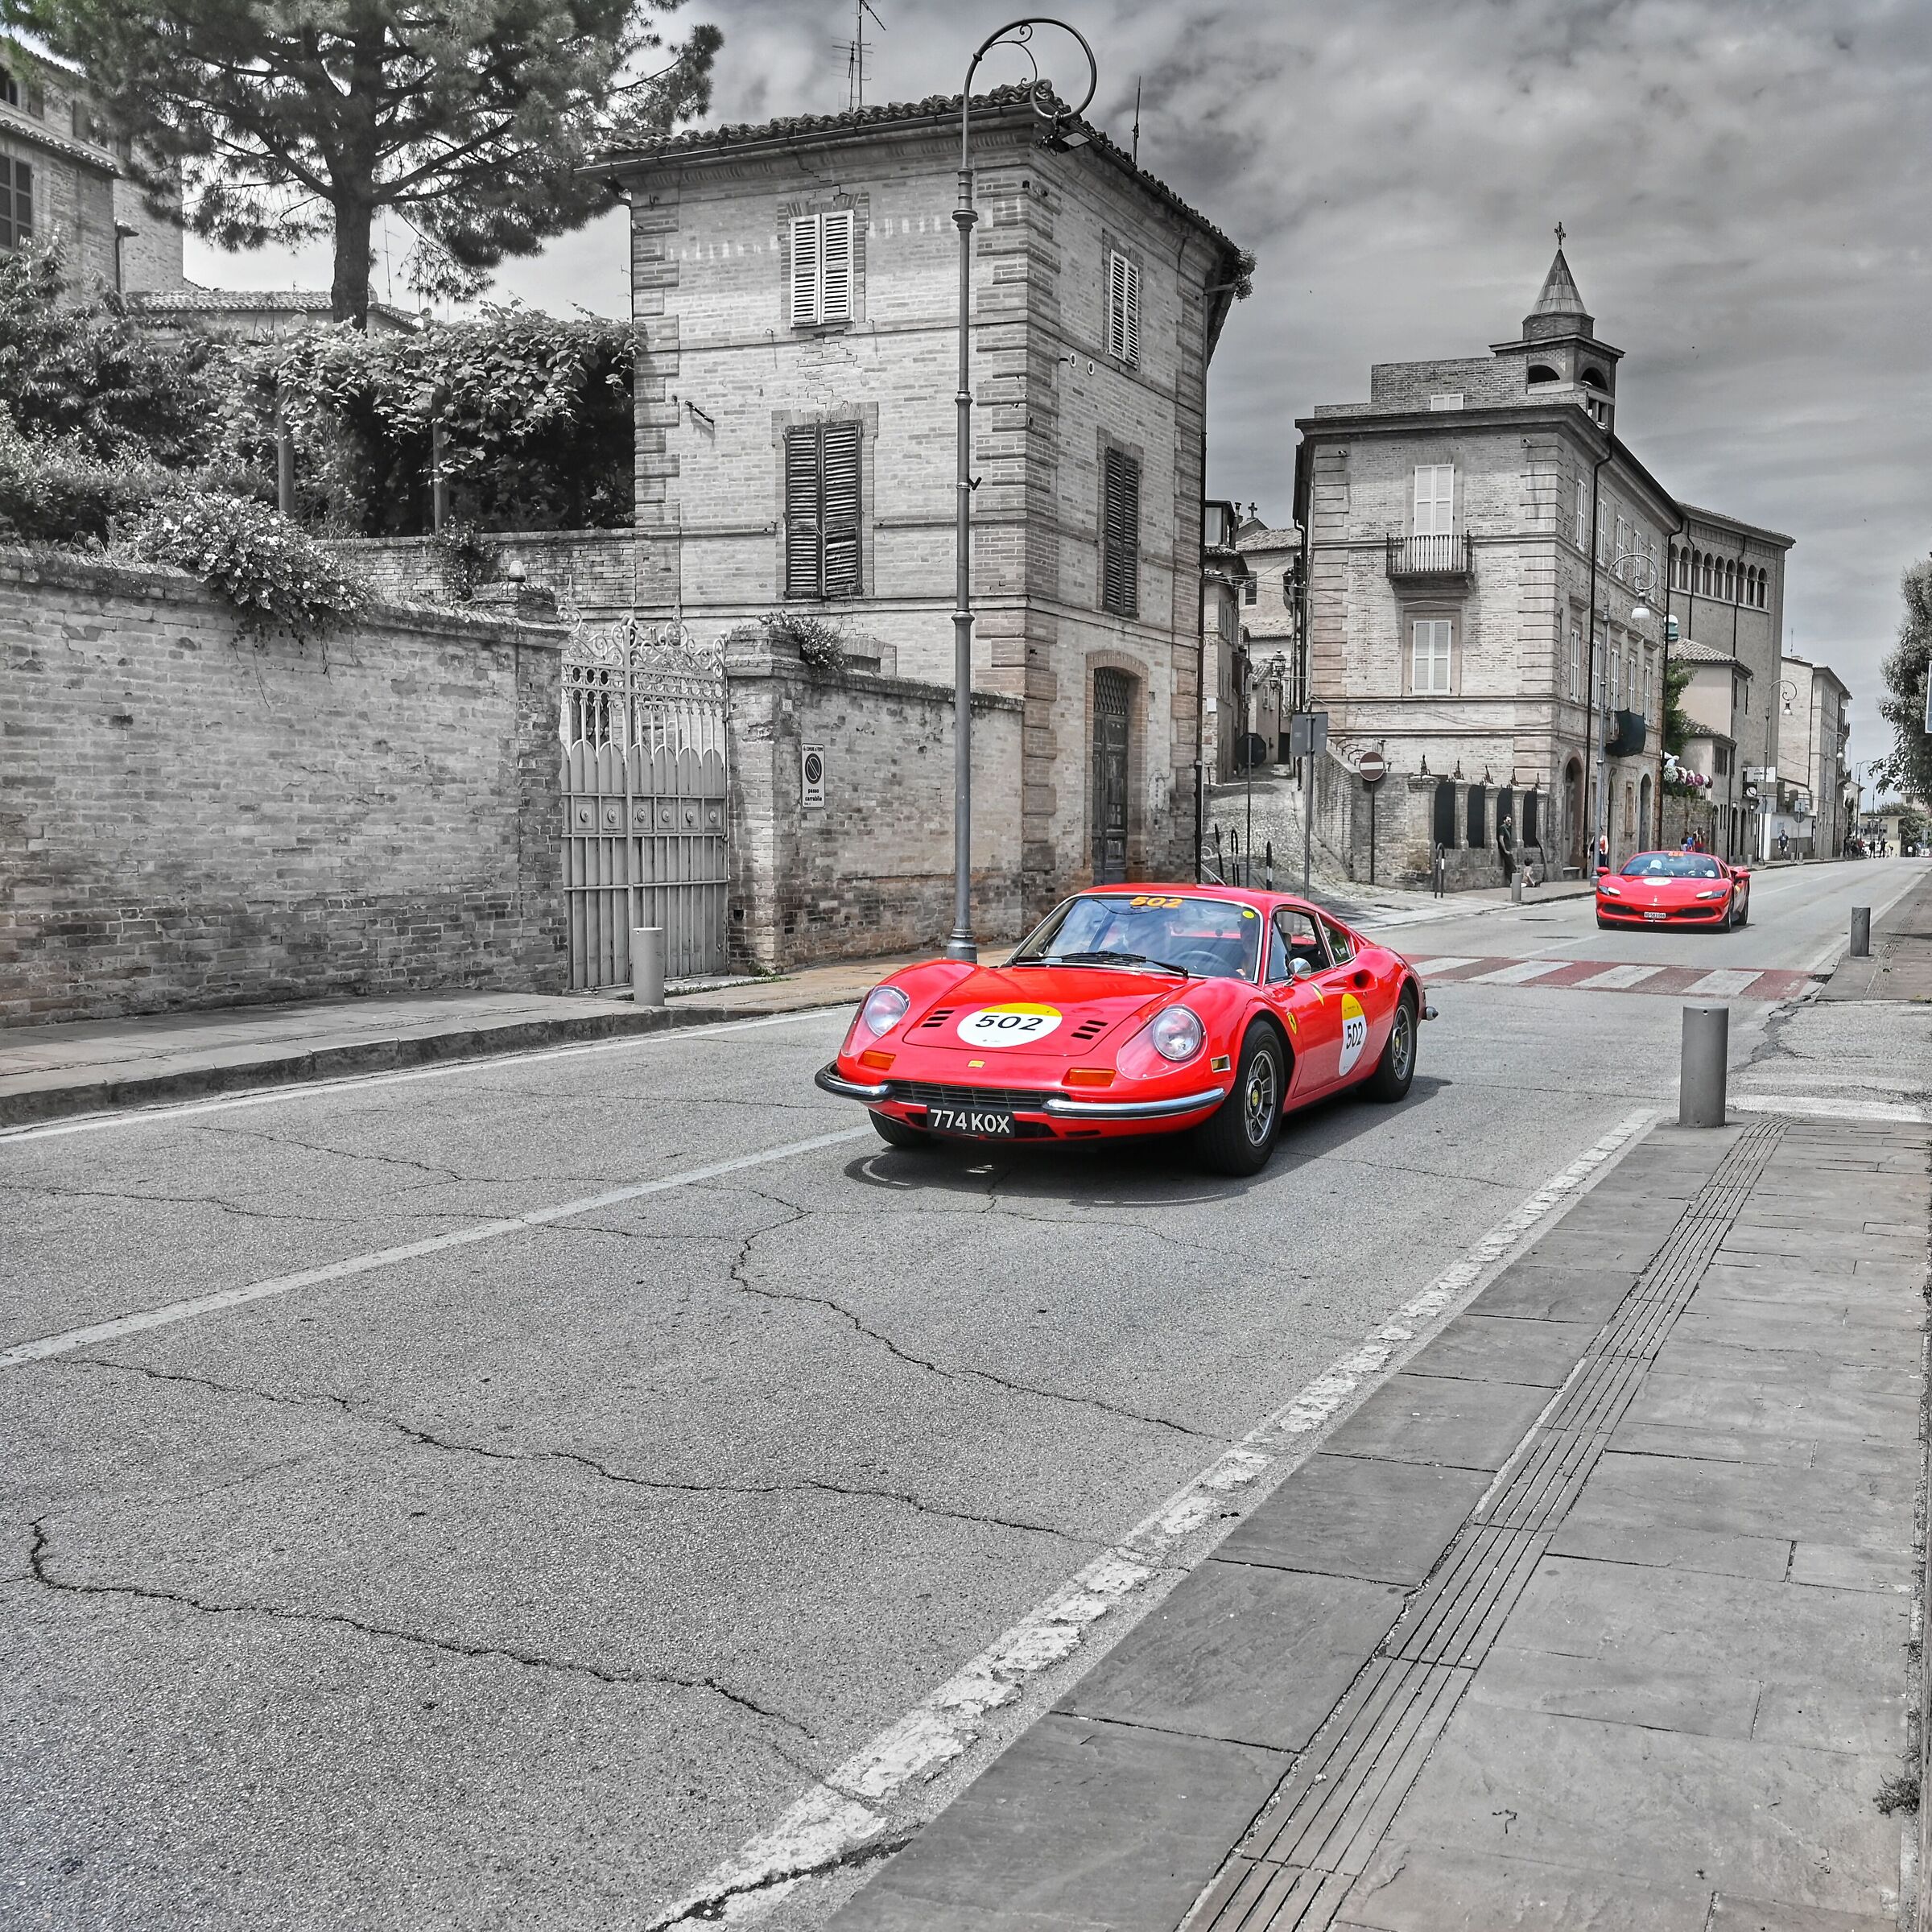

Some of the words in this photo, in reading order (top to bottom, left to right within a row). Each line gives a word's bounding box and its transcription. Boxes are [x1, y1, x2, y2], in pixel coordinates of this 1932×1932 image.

[1129, 896, 1183, 909] 502
[975, 1015, 1043, 1031] 502
[1346, 1021, 1363, 1050] 502
